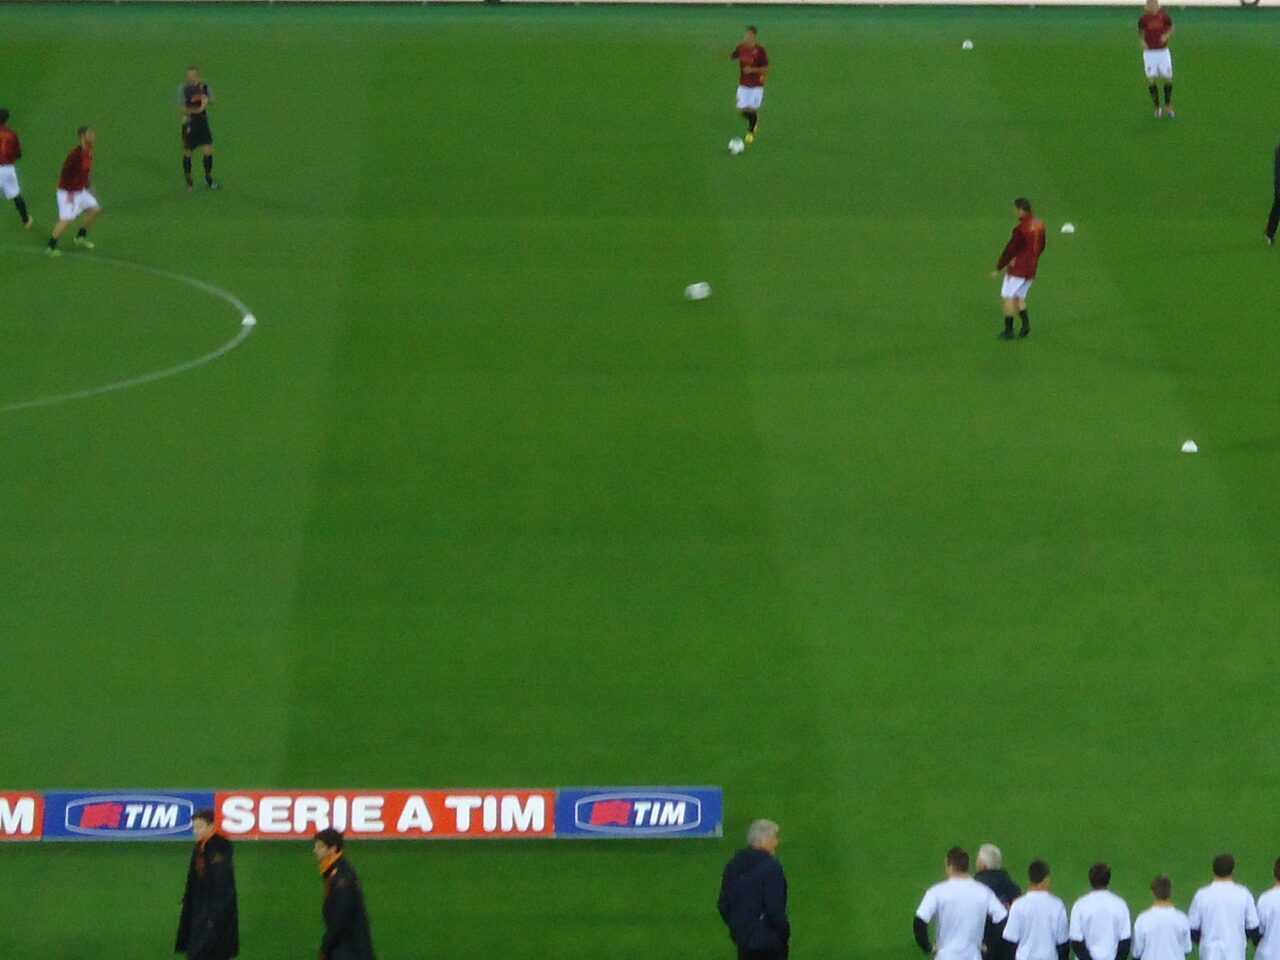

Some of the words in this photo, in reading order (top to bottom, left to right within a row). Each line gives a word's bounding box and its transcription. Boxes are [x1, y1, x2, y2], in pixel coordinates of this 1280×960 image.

[124, 803, 179, 829] TIM
[221, 795, 385, 833] SERIE
[396, 795, 434, 832] A
[444, 795, 545, 832] TIM
[633, 801, 687, 826] TIM
